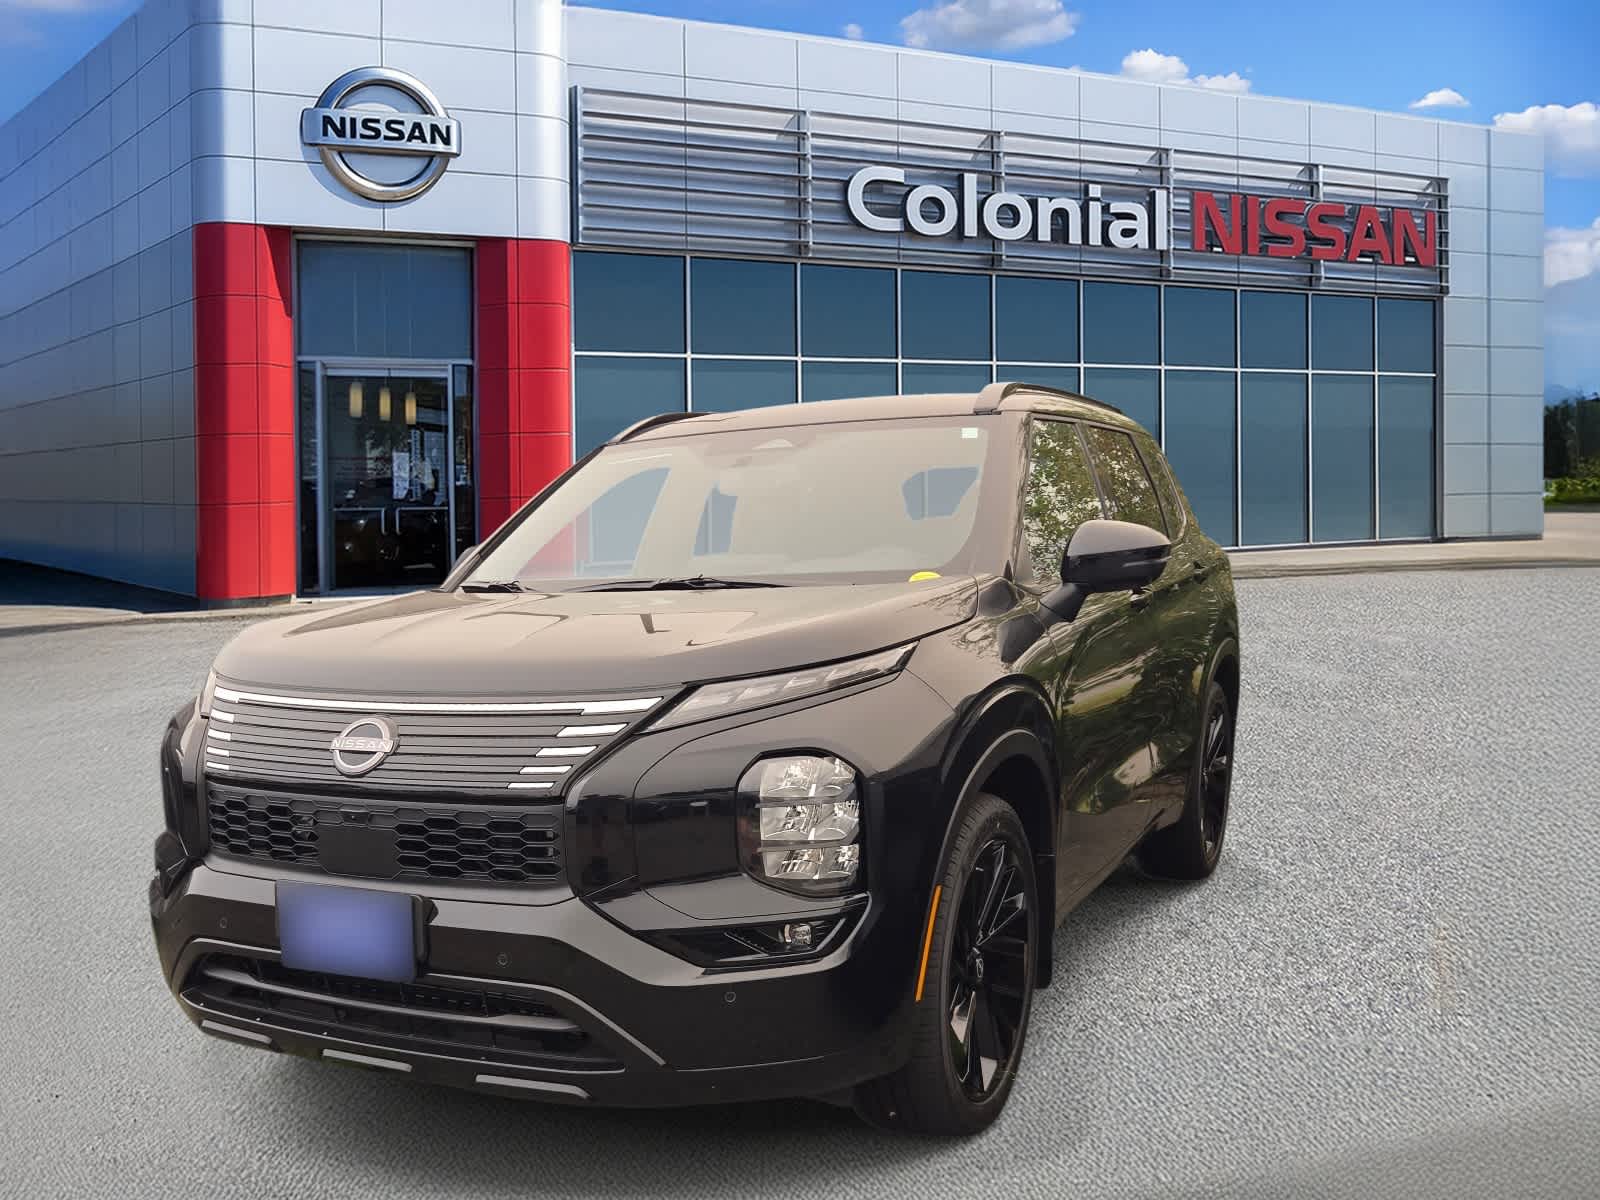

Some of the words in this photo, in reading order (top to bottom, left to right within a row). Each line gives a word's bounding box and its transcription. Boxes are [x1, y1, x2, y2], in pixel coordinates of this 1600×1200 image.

[321, 115, 452, 146] NISSAN
[847, 166, 1168, 250] Colonial
[1192, 191, 1437, 267] NISSAN
[332, 739, 390, 752] NISSAN
